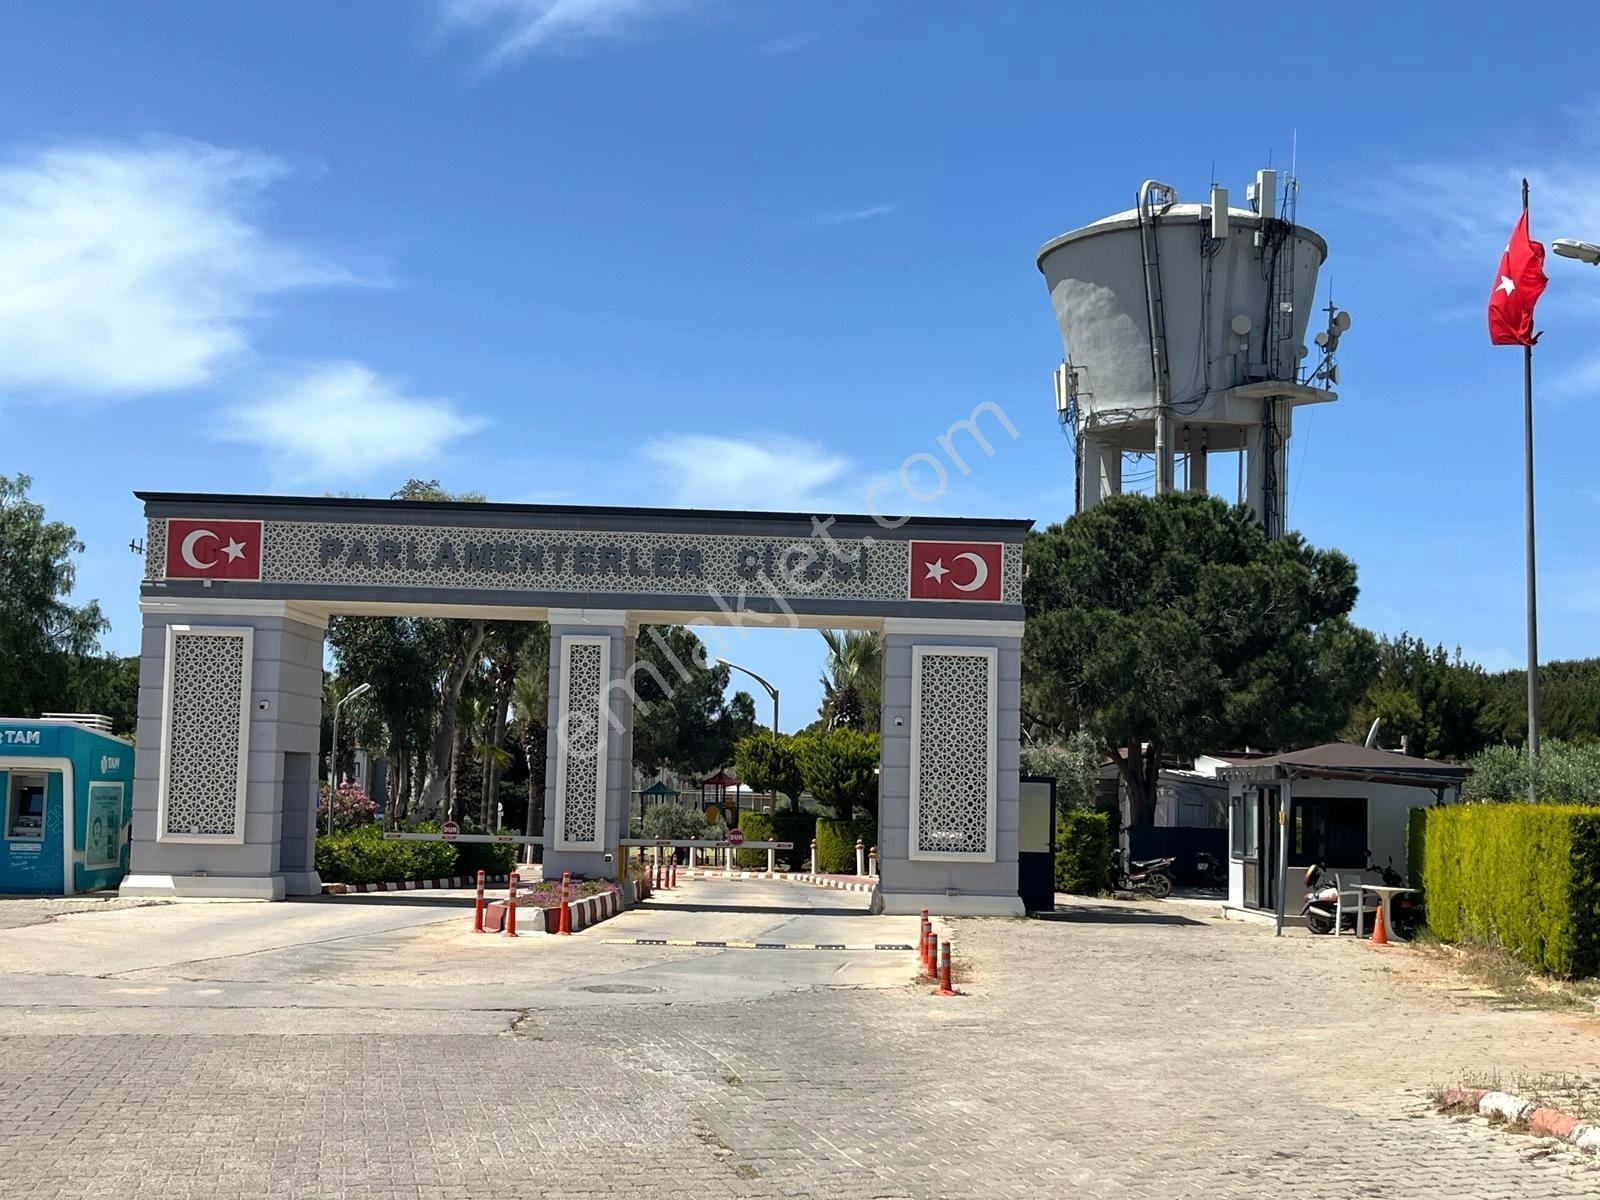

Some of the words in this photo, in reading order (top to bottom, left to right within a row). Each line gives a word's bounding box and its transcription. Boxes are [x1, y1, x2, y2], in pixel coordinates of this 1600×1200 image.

[319, 537, 701, 578] PARLAMENTERLER
[4, 730, 41, 744] TAM
[107, 757, 120, 769] TAM
